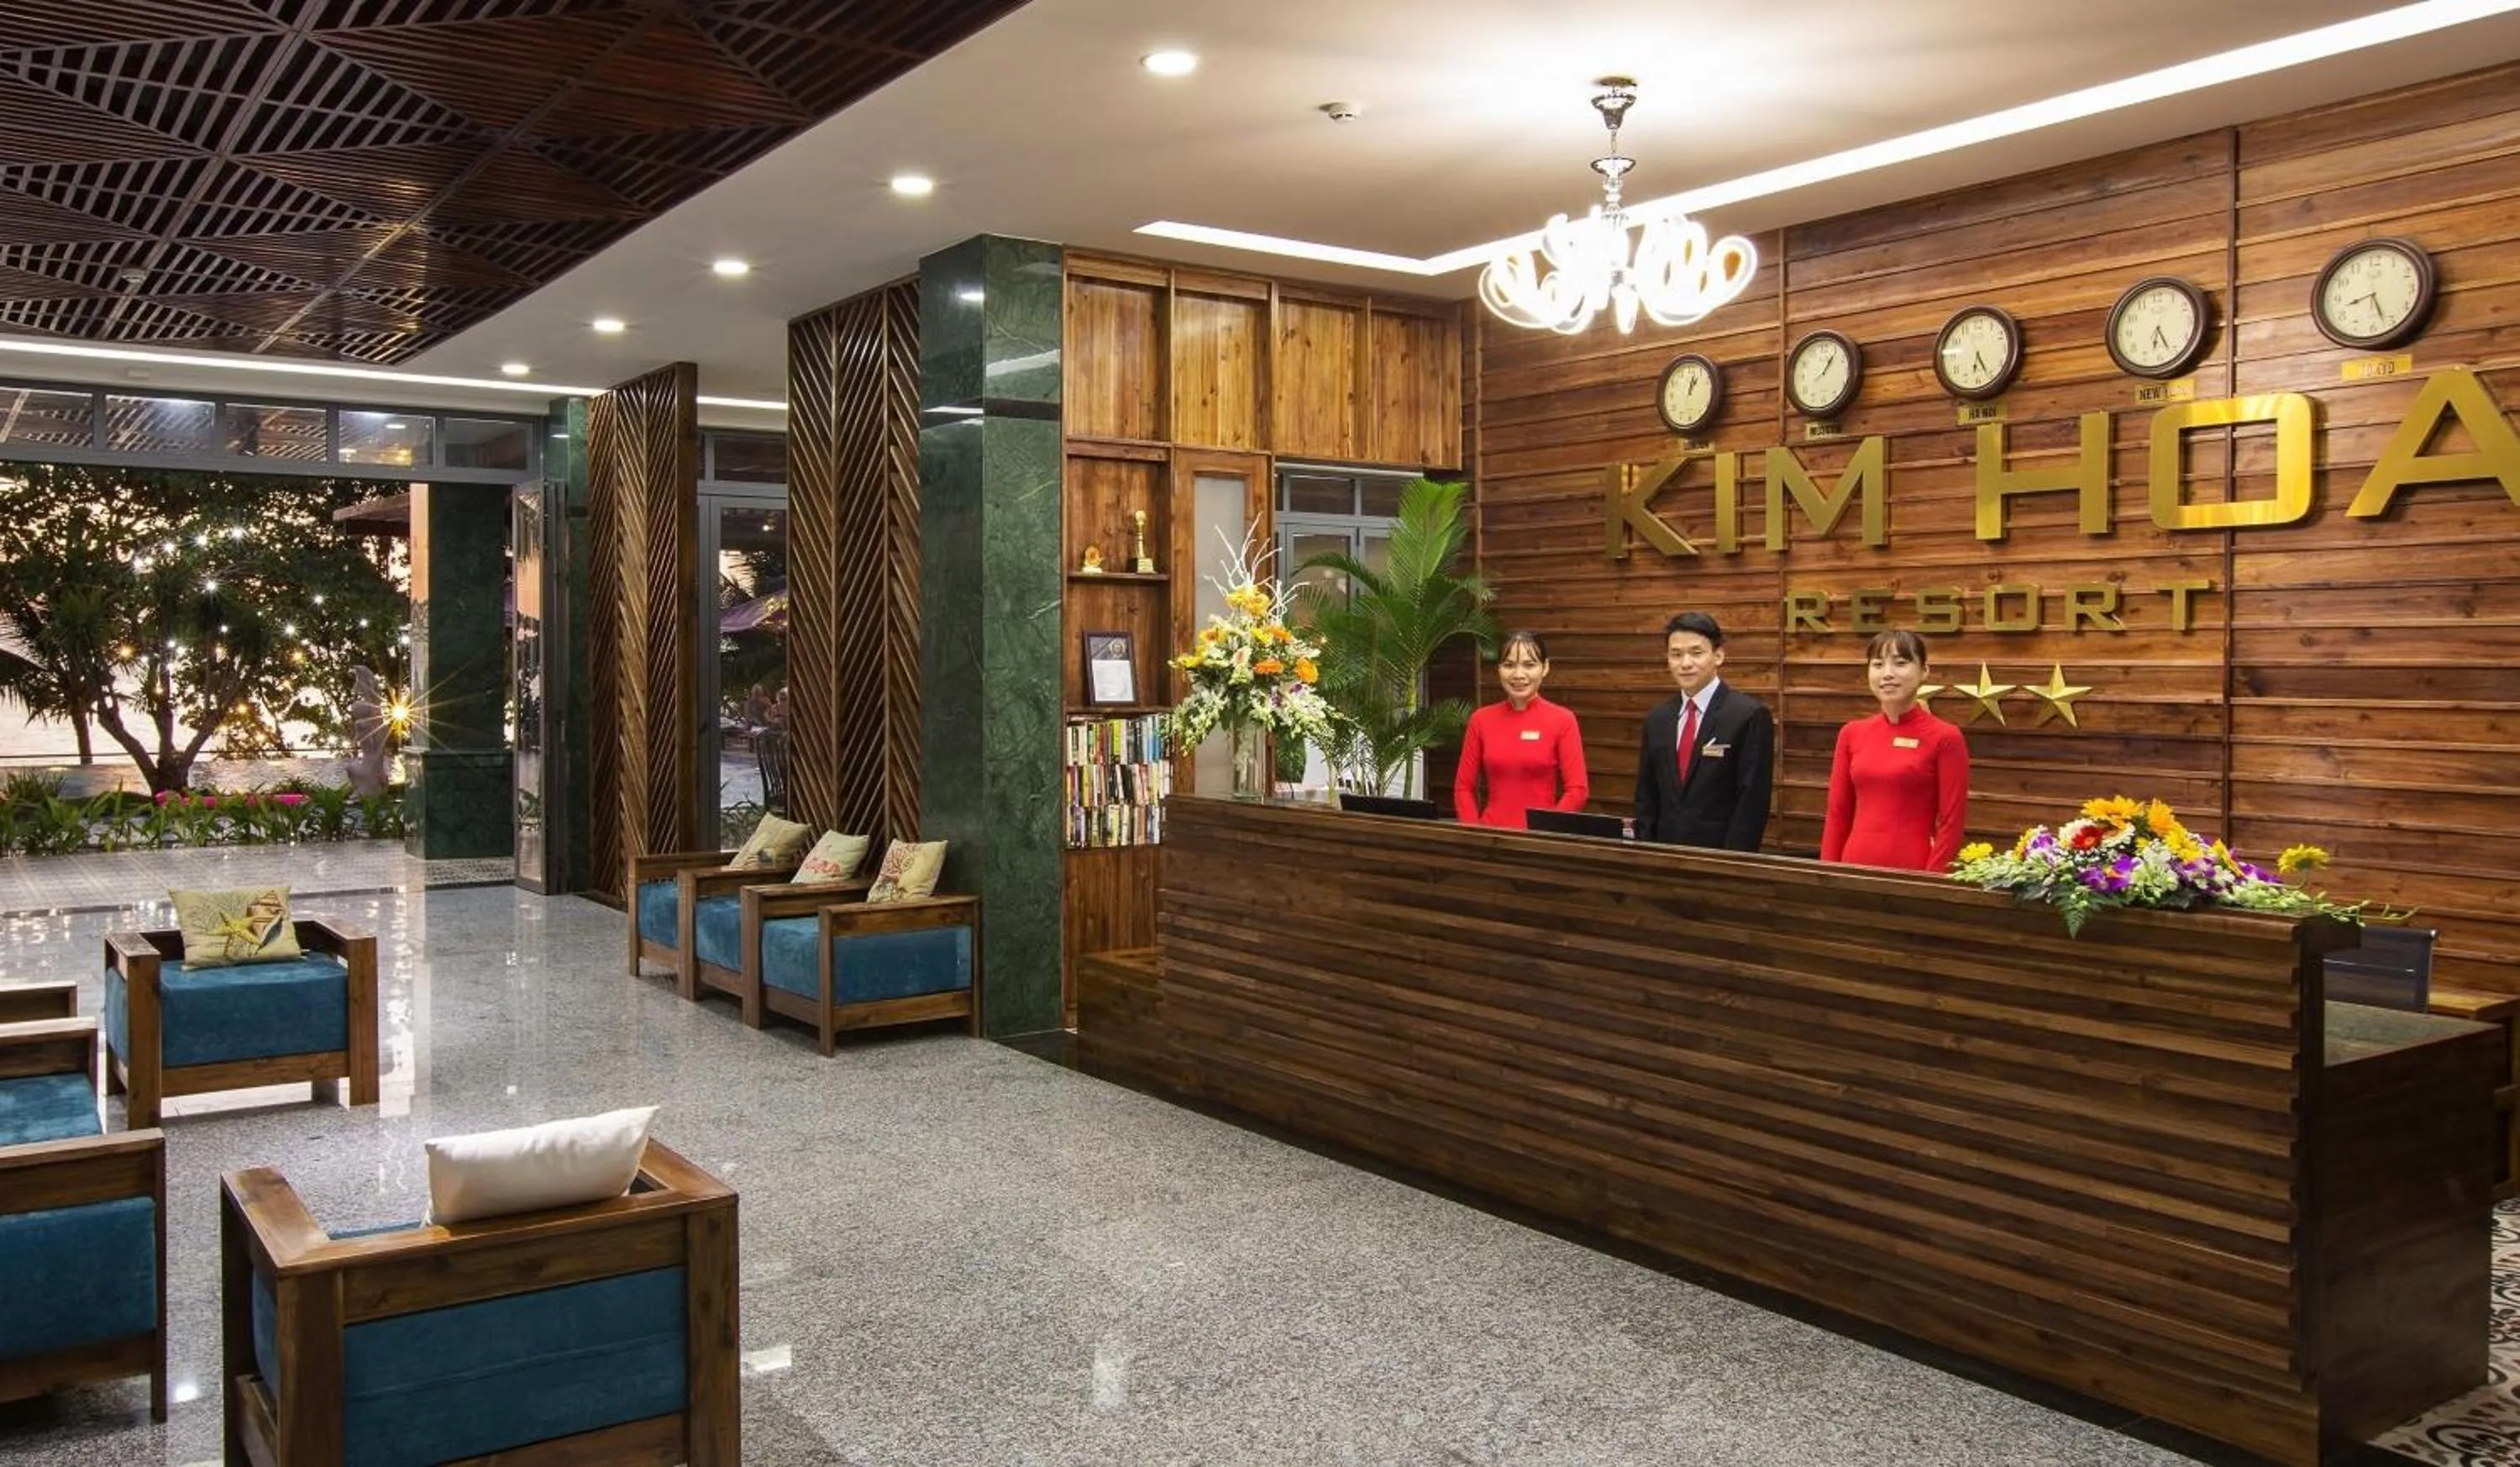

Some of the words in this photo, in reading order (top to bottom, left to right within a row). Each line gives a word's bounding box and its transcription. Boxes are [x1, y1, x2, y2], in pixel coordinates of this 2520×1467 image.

[2139, 386, 2161, 401] NEW
[1604, 435, 1888, 560] KIM
[1975, 364, 2520, 540] HOA
[1785, 580, 2218, 634] RESORT
